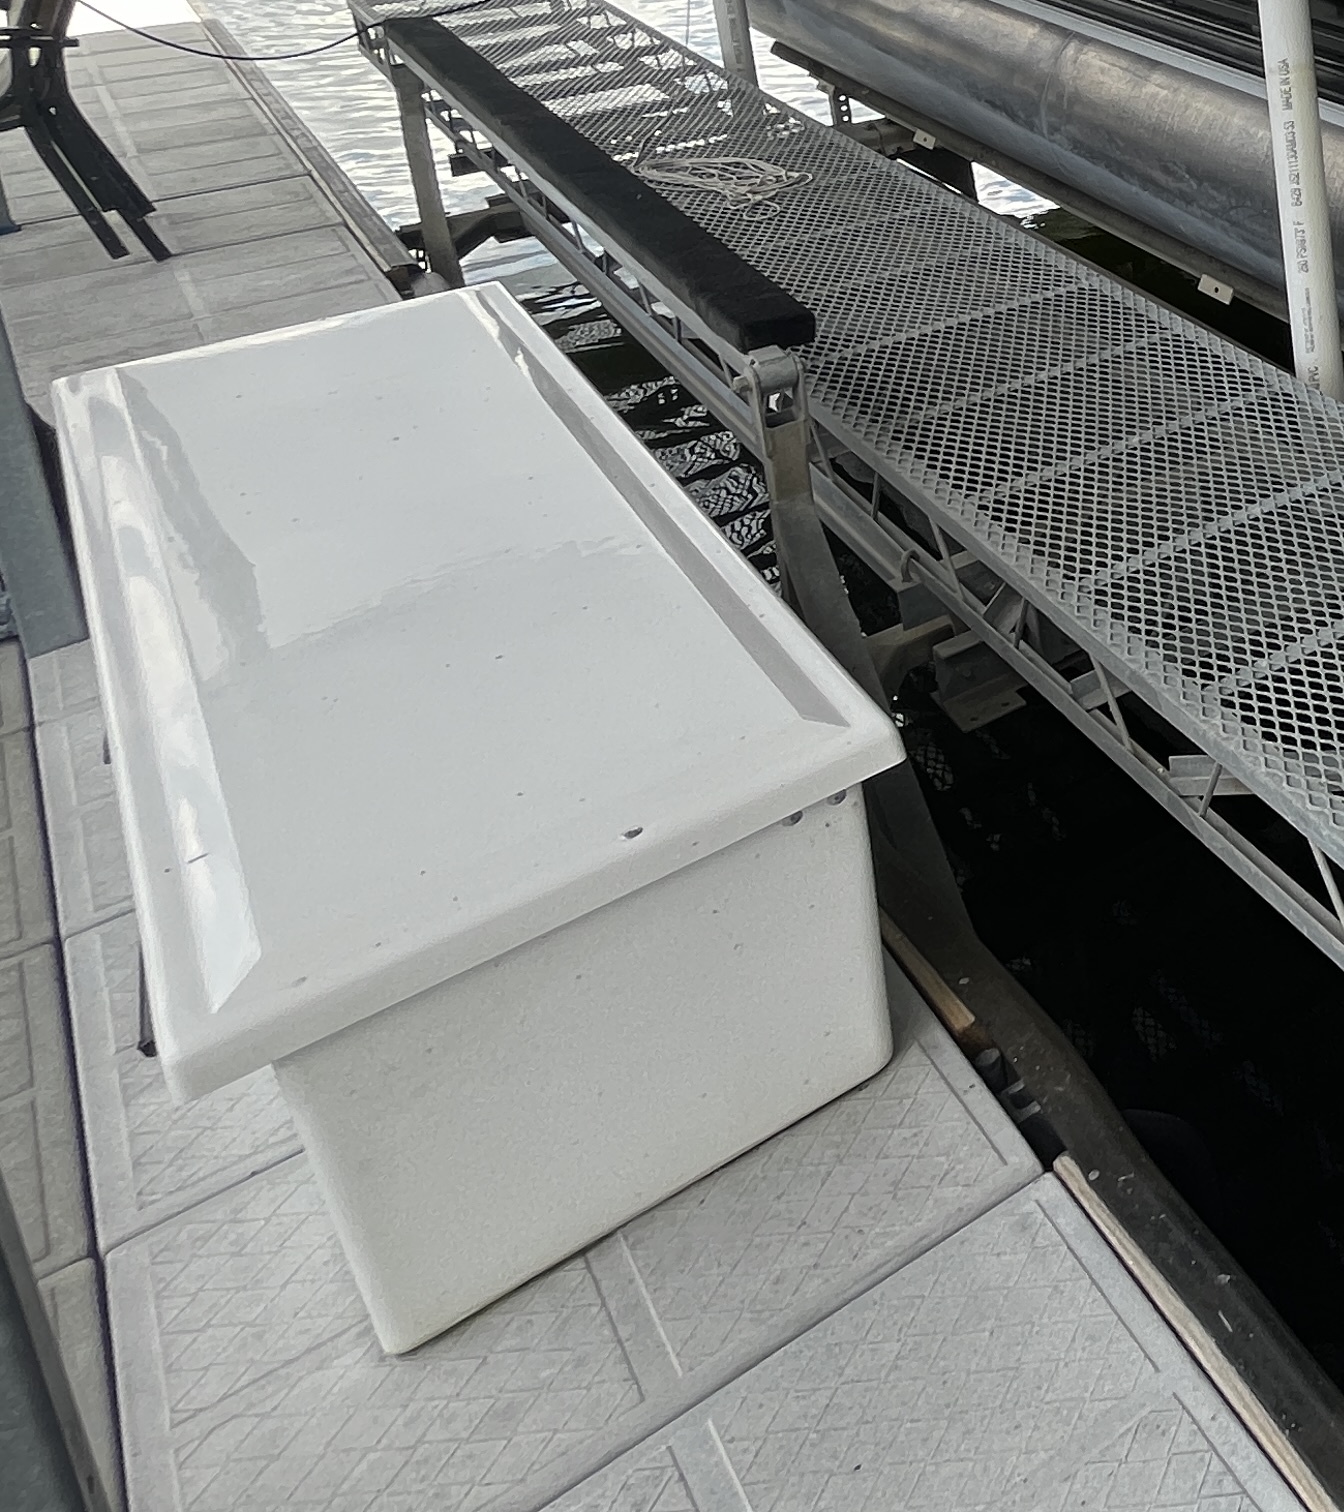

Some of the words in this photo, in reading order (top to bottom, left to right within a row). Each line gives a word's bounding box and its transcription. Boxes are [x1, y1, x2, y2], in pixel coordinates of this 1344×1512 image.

[1276, 58, 1290, 76] USA
[1278, 77, 1291, 86] IN
[1279, 86, 1294, 110] MADE
